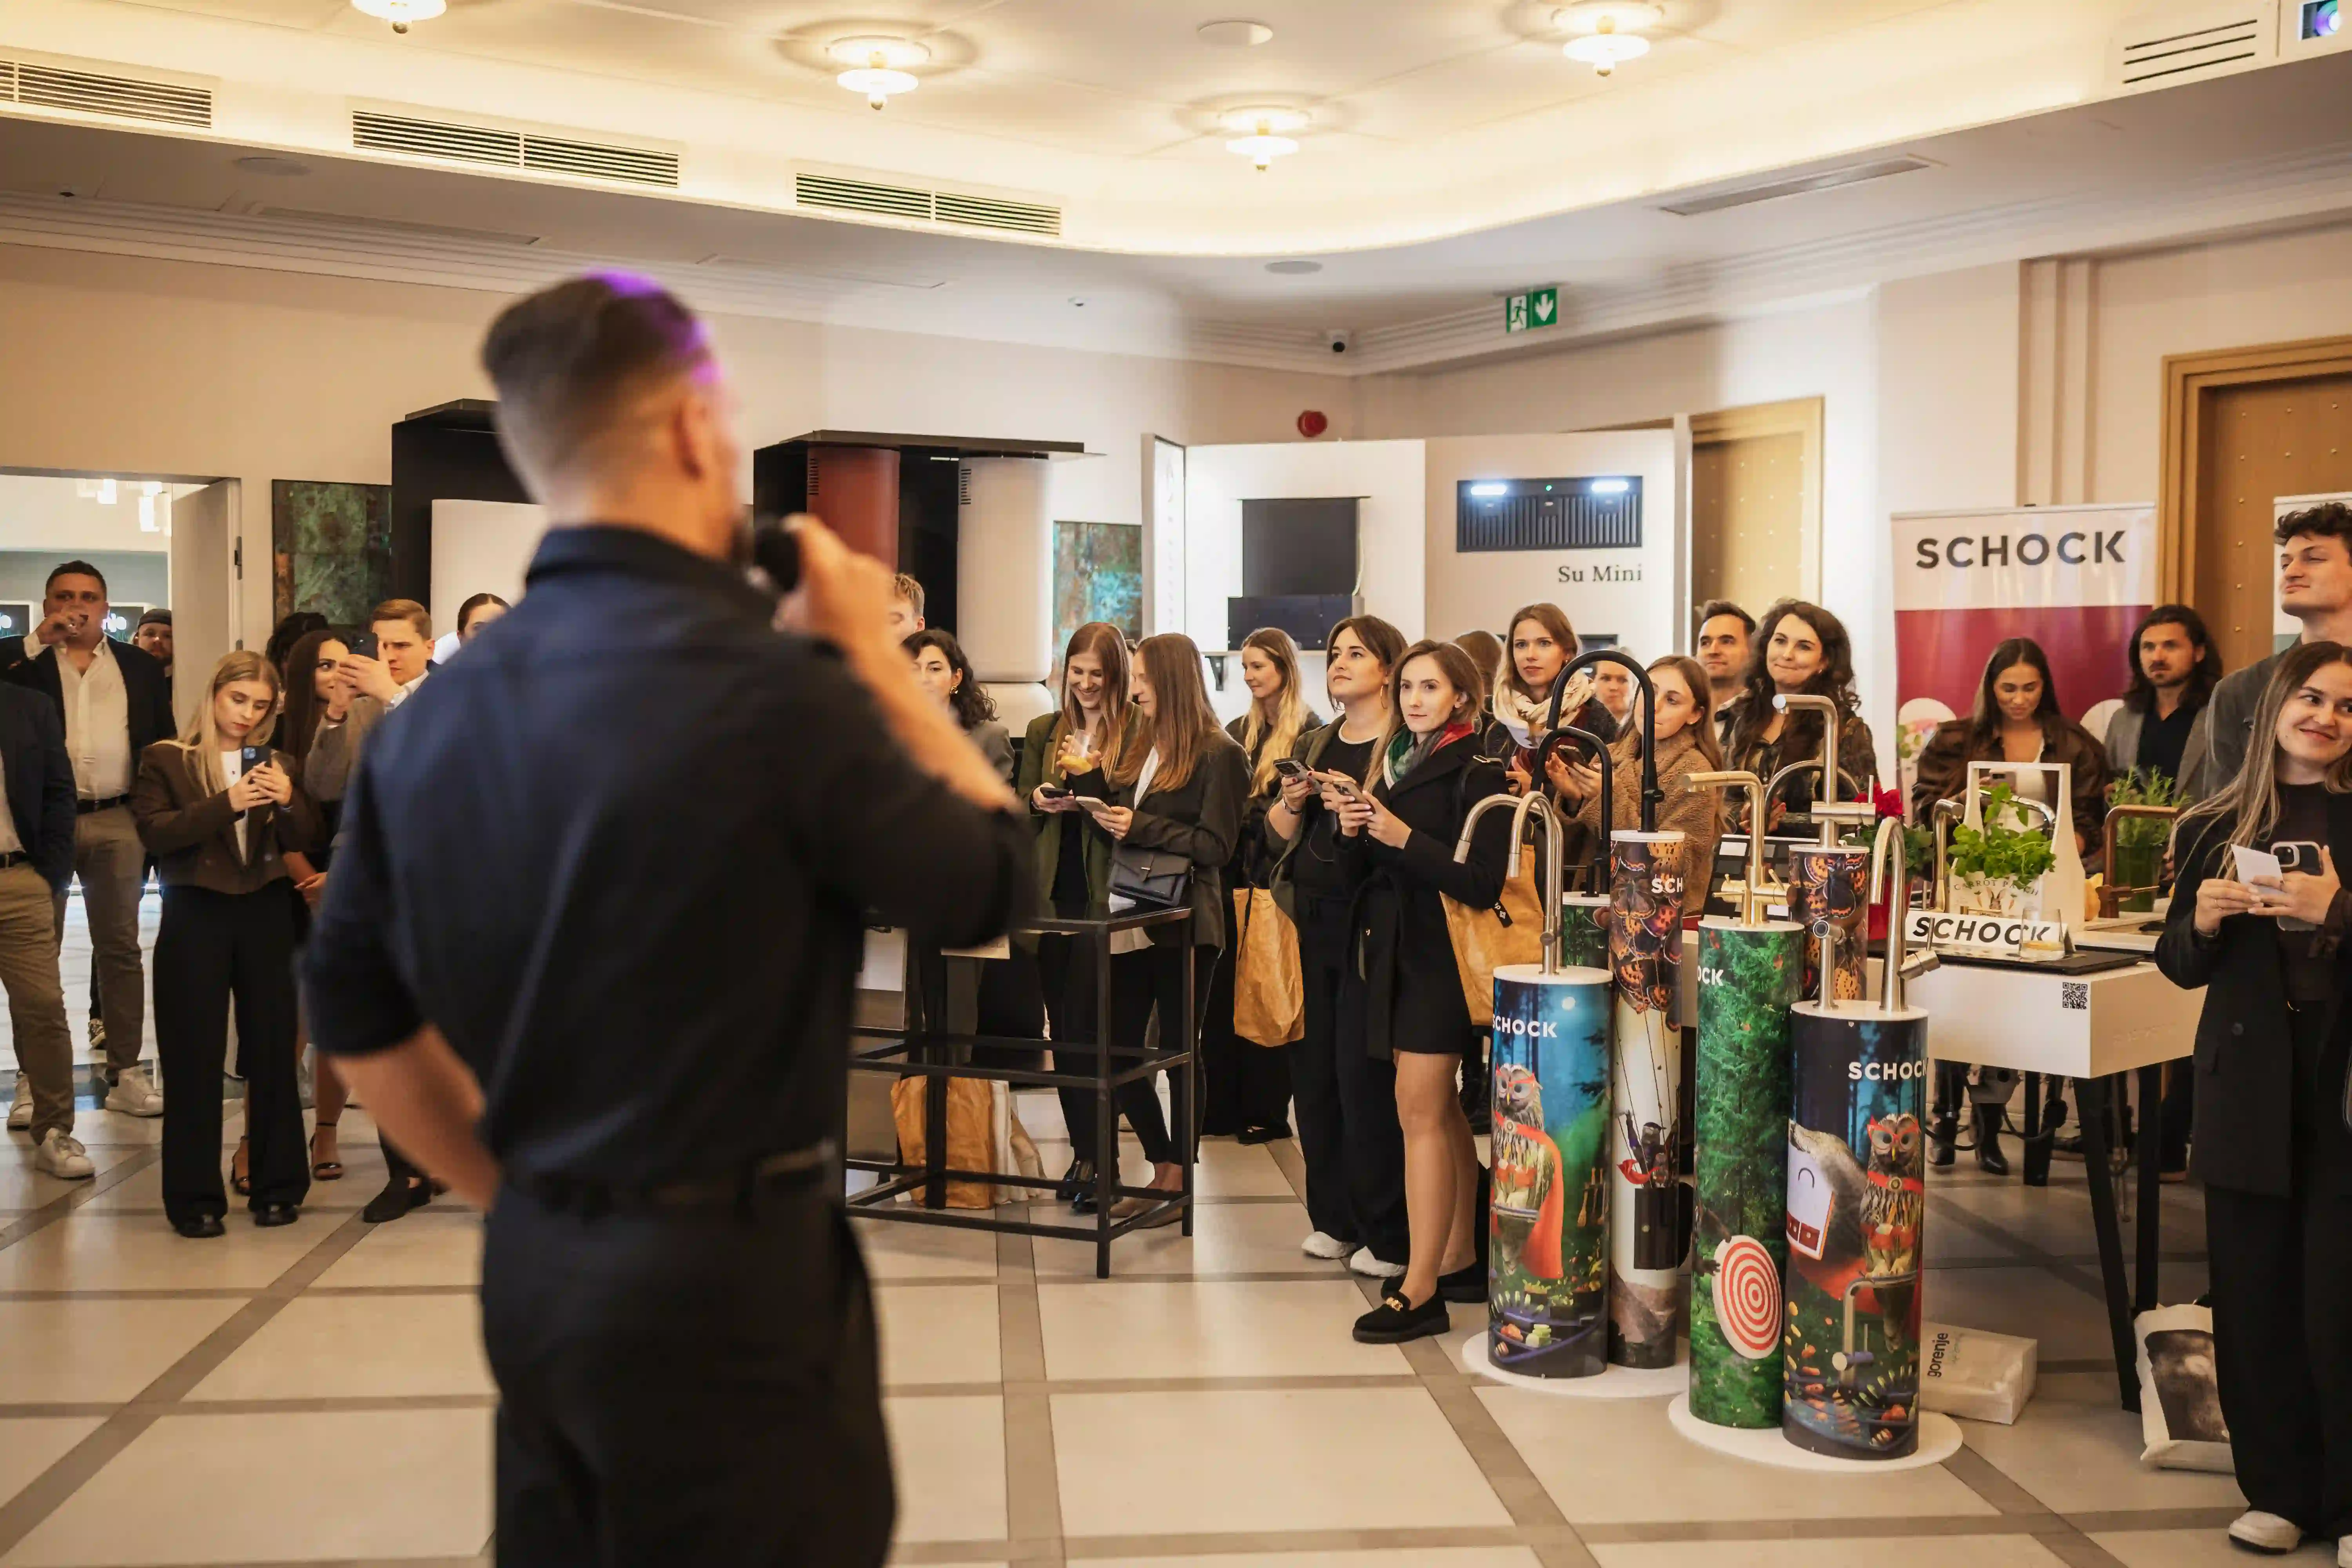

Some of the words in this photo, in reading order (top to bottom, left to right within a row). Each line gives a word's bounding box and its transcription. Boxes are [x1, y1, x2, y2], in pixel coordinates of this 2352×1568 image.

[1916, 530, 2126, 569] SCHOCK
[1558, 566, 1584, 582] Su
[1592, 563, 1641, 582] Mini
[1913, 916, 2050, 945] SCHOCK
[1927, 1333, 1950, 1377] gorenje
